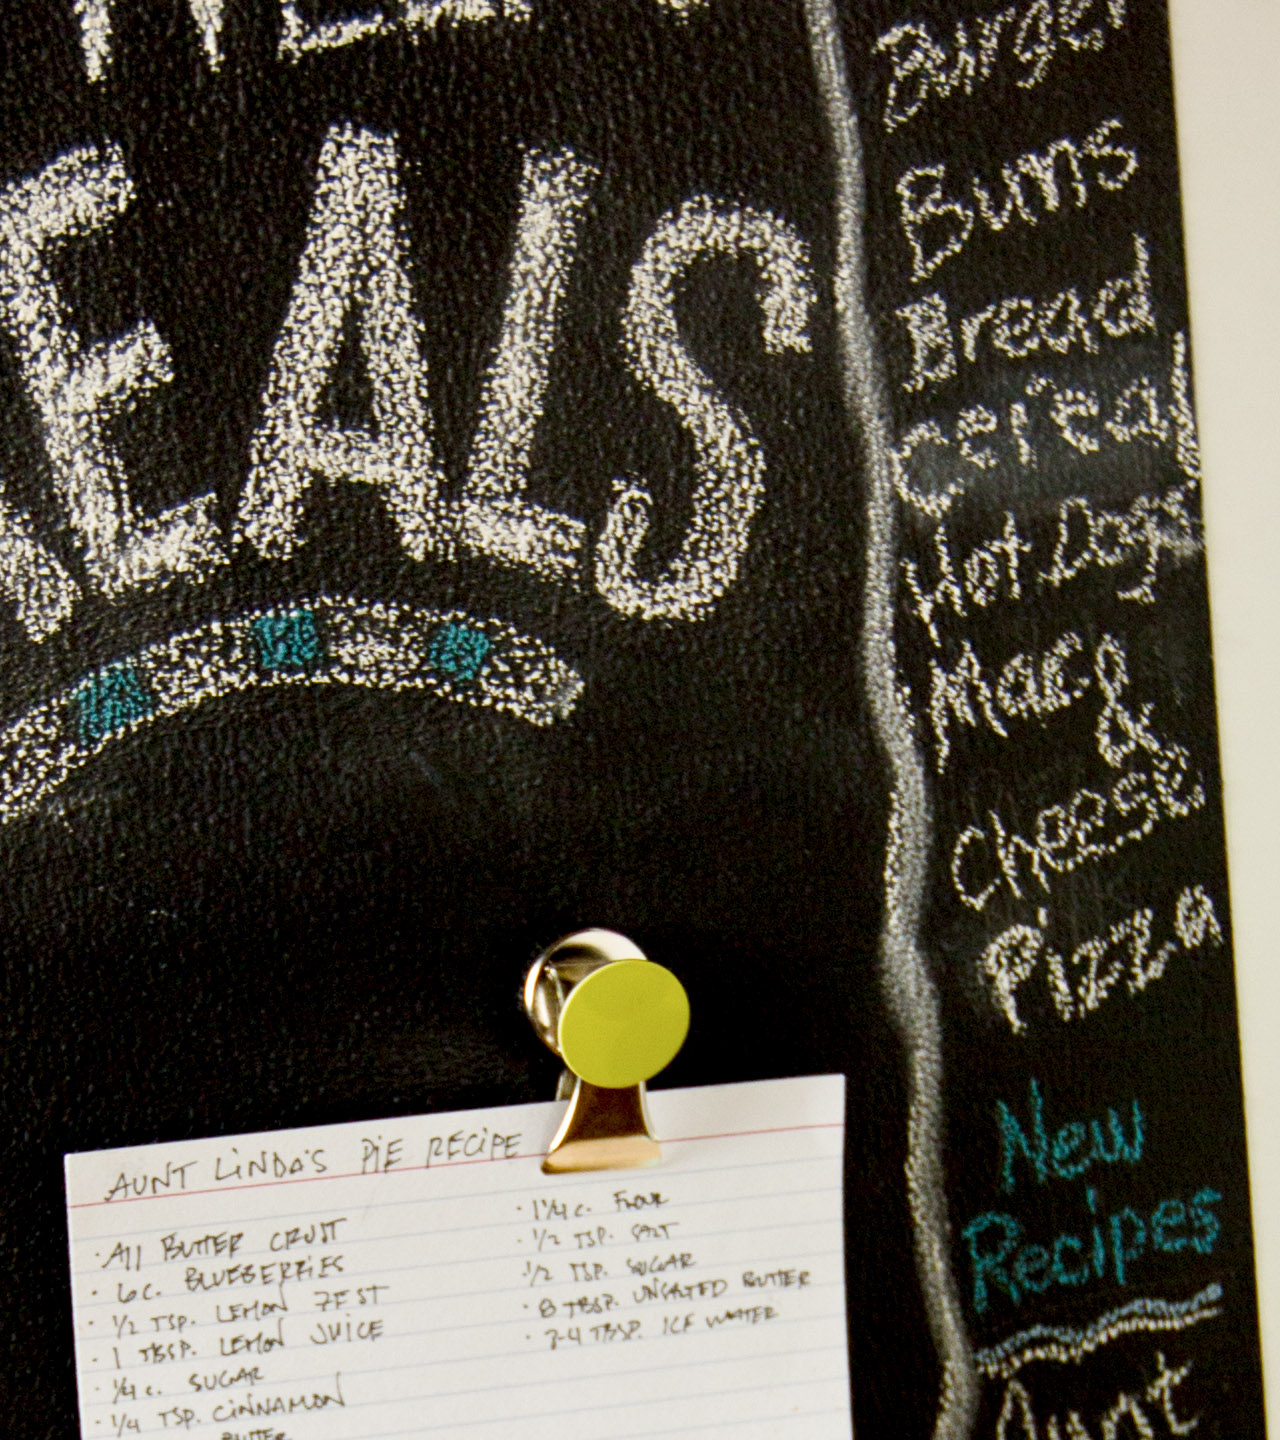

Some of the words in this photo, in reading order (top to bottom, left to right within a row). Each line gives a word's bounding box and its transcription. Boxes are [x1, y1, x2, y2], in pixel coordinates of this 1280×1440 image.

[896, 233, 1157, 393] Bread
[927, 632, 1090, 774] Mac
[1094, 633, 1157, 769] &
[104, 1161, 199, 1203] AUNT
[996, 1076, 1144, 1193] New
[962, 1186, 1223, 1315] Recipes
